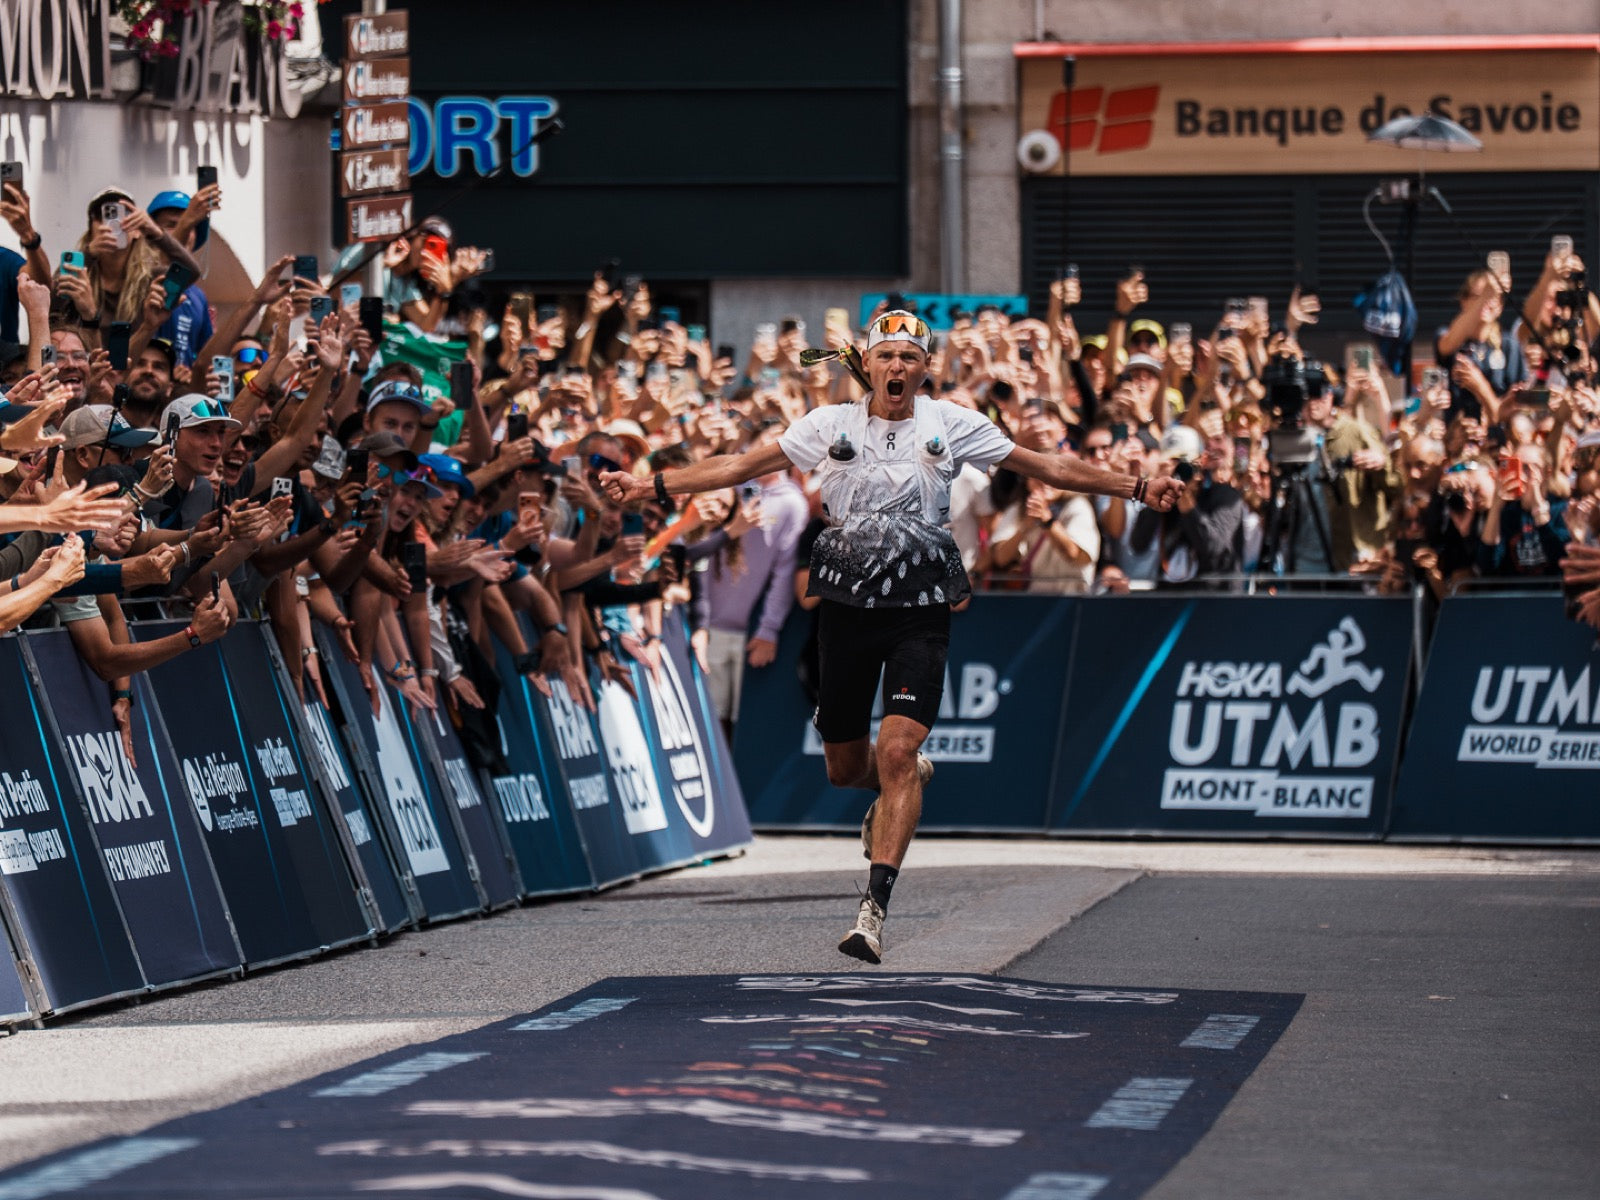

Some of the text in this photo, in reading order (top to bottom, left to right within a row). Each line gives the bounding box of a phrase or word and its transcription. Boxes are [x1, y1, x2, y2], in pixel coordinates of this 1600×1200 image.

[1175, 99, 1345, 146] Banque
[1428, 91, 1582, 133] Savoie
[892, 694, 916, 702] TUDOR
[1176, 661, 1282, 698] HOKA
[1471, 662, 1600, 726] UTM
[926, 736, 985, 755] ERIES
[1169, 699, 1380, 770] UTMB
[1469, 735, 1541, 755] WORLD
[67, 730, 155, 824] HOKA
[194, 757, 212, 798] La
[205, 751, 248, 805] Région
[493, 774, 550, 823] TUDOR
